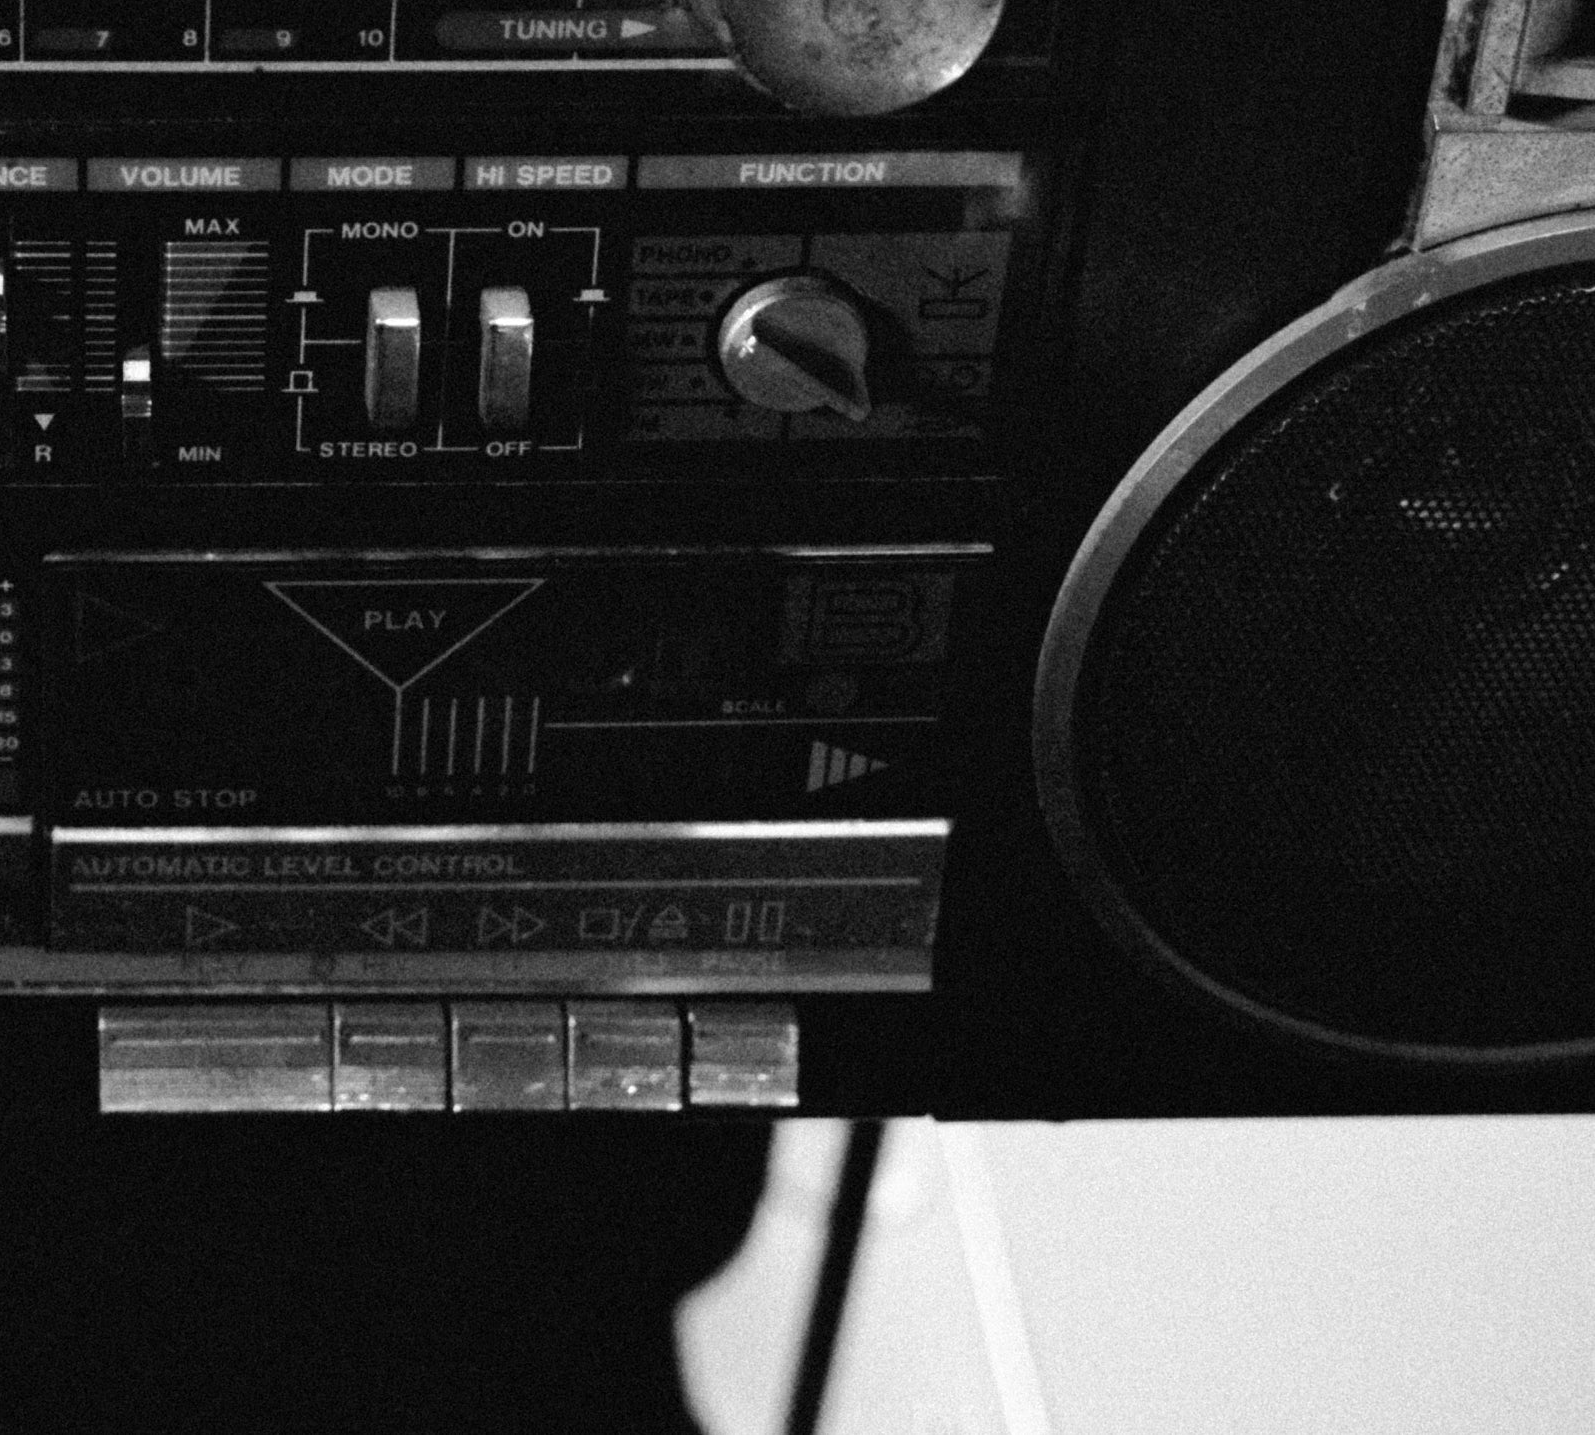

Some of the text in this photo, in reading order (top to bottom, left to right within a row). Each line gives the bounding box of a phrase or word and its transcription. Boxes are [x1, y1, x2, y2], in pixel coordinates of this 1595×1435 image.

[95, 30, 110, 48] 7
[182, 29, 198, 48] 8
[276, 29, 292, 48] 9
[358, 29, 385, 48] 10
[498, 19, 609, 40] TUNING
[120, 166, 242, 188] VOLUME
[326, 164, 414, 187] MODE
[476, 164, 614, 187] HI SPEED
[738, 161, 888, 184] FUNCTION
[184, 217, 241, 236] MAX
[341, 220, 420, 240] MONO
[507, 220, 545, 239] ON
[34, 444, 52, 463] R
[178, 445, 222, 463] MIN
[319, 440, 419, 459] STEREO
[485, 440, 533, 458] OFF
[363, 610, 448, 633] PLAY
[73, 788, 259, 810] AUTO STOP
[70, 855, 248, 877] AUTOMATIC
[263, 855, 361, 877] LEVEL
